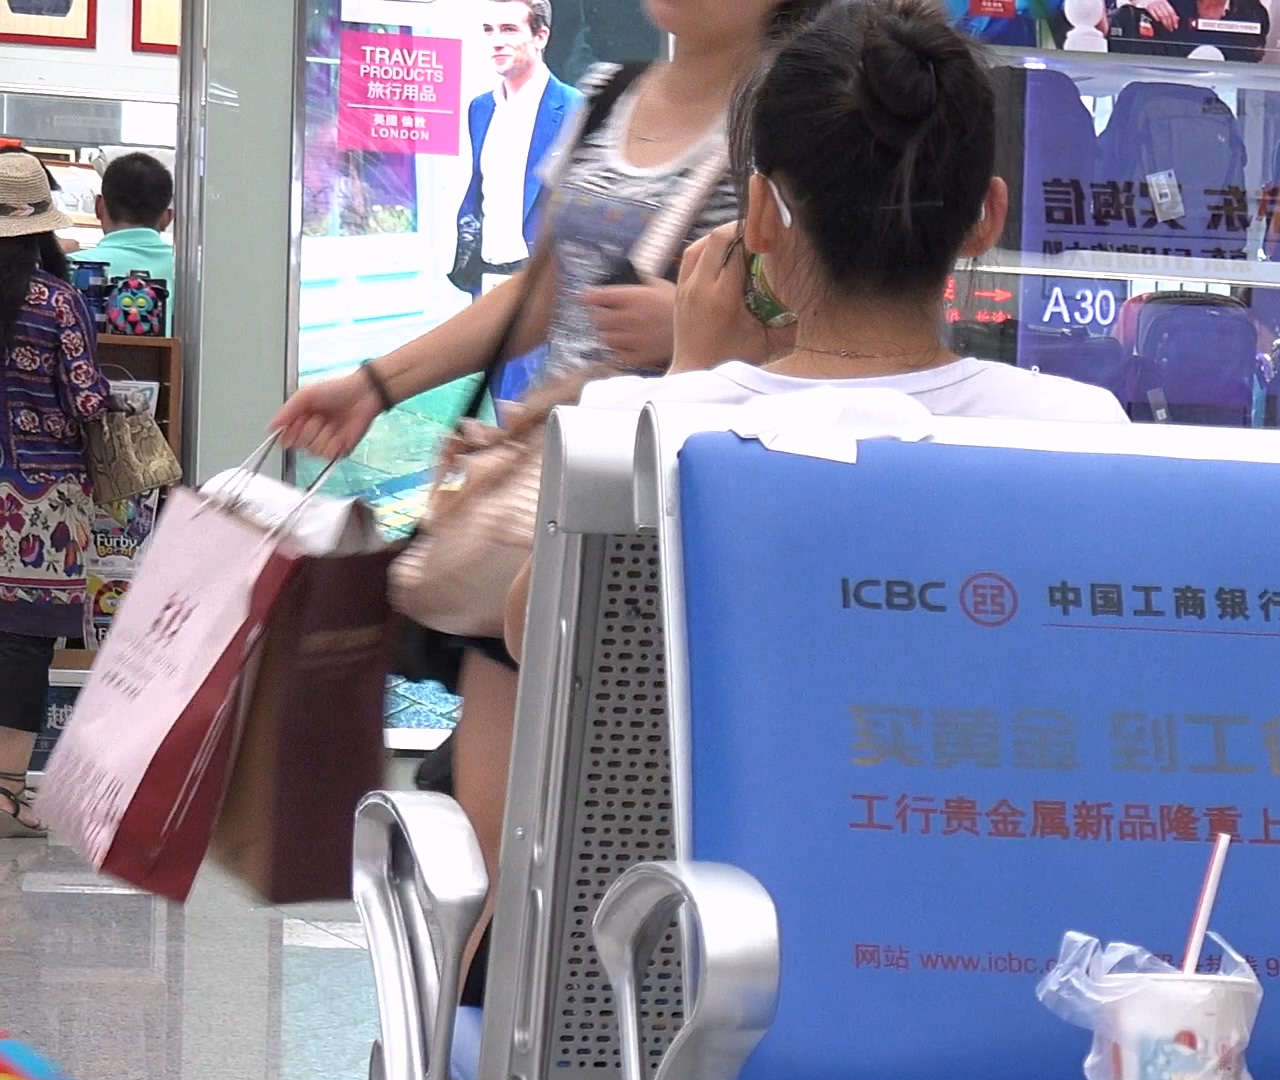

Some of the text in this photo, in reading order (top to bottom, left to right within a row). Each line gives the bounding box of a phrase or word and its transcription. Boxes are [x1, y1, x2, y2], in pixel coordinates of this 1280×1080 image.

[361, 46, 443, 69] TRAVEL
[360, 65, 444, 82] PRODUCTS
[367, 82, 437, 102] 旅行用品
[371, 128, 430, 140] LONDON
[1042, 286, 1116, 326] A30
[96, 533, 137, 549] Furby
[840, 577, 947, 614] ICBC
[850, 703, 1080, 771] 买黄金
[855, 943, 910, 970] 网站
